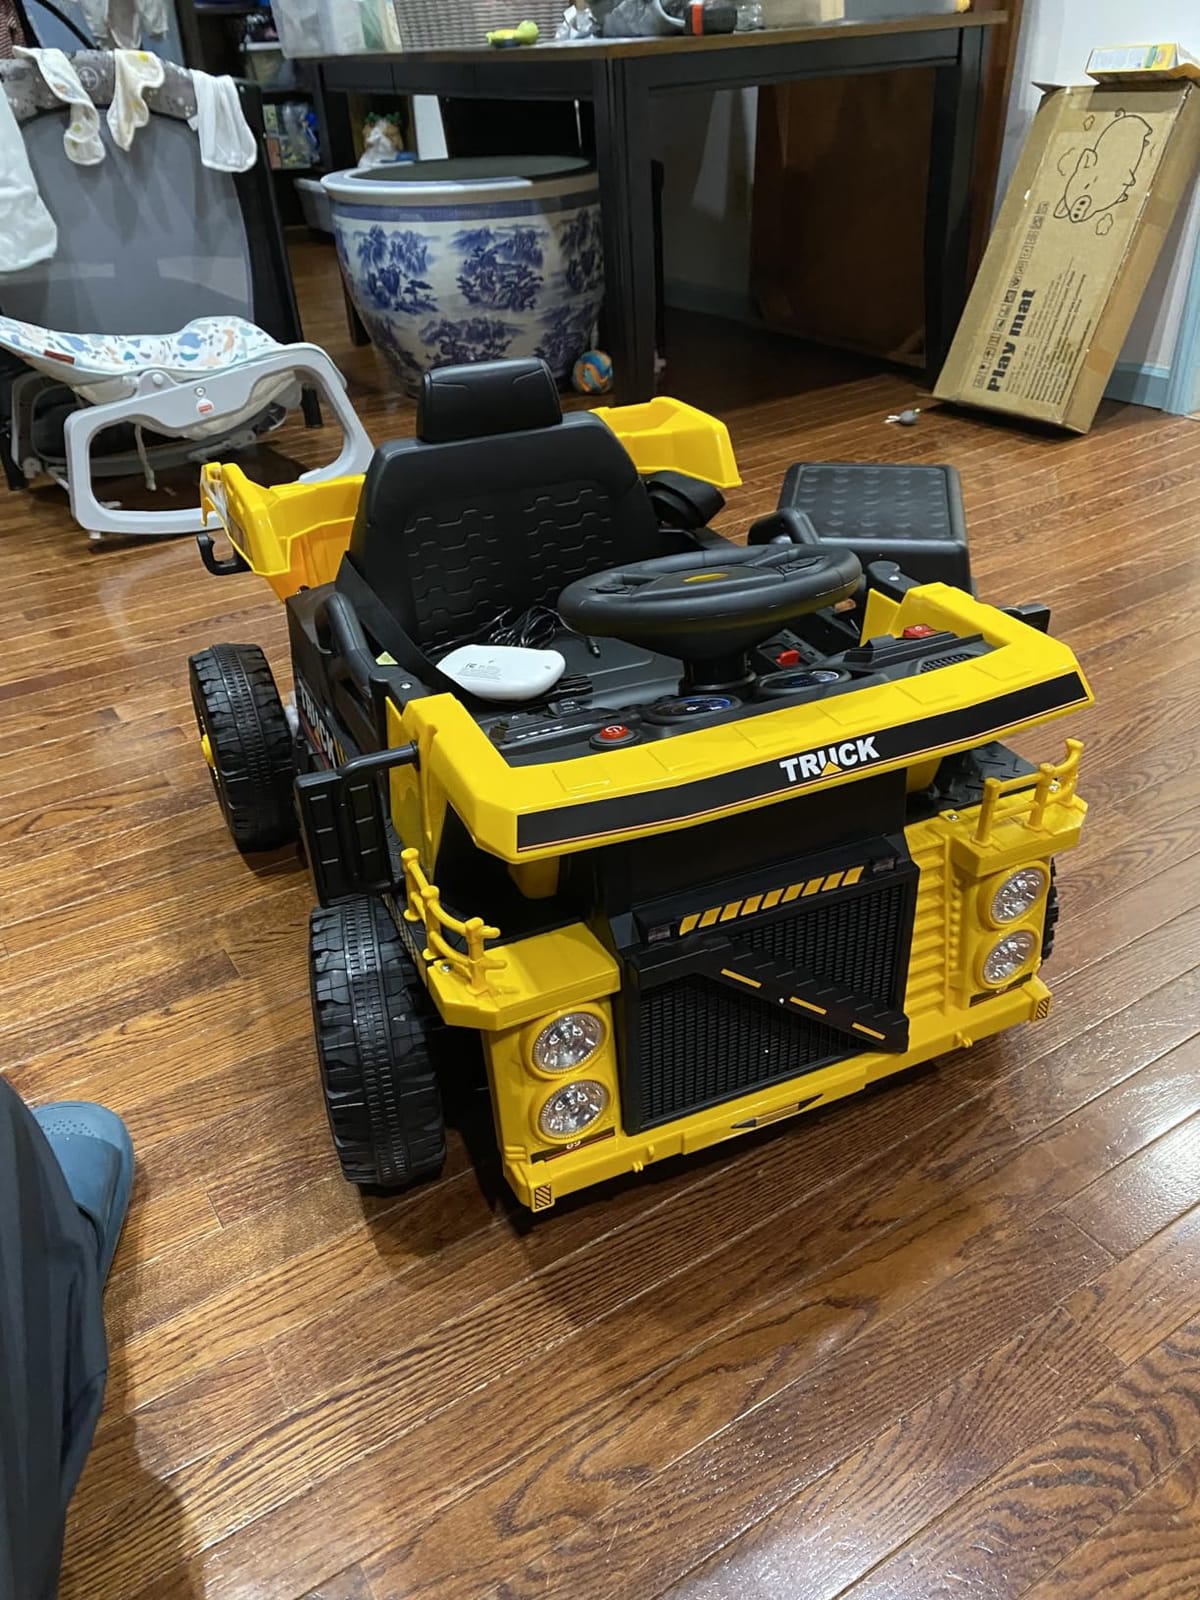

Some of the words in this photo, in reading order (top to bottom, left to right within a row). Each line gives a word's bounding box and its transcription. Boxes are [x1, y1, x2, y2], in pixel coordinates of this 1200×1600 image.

[987, 341, 1016, 392] Play
[1009, 289, 1036, 336] mat
[779, 736, 880, 782] TRUCK
